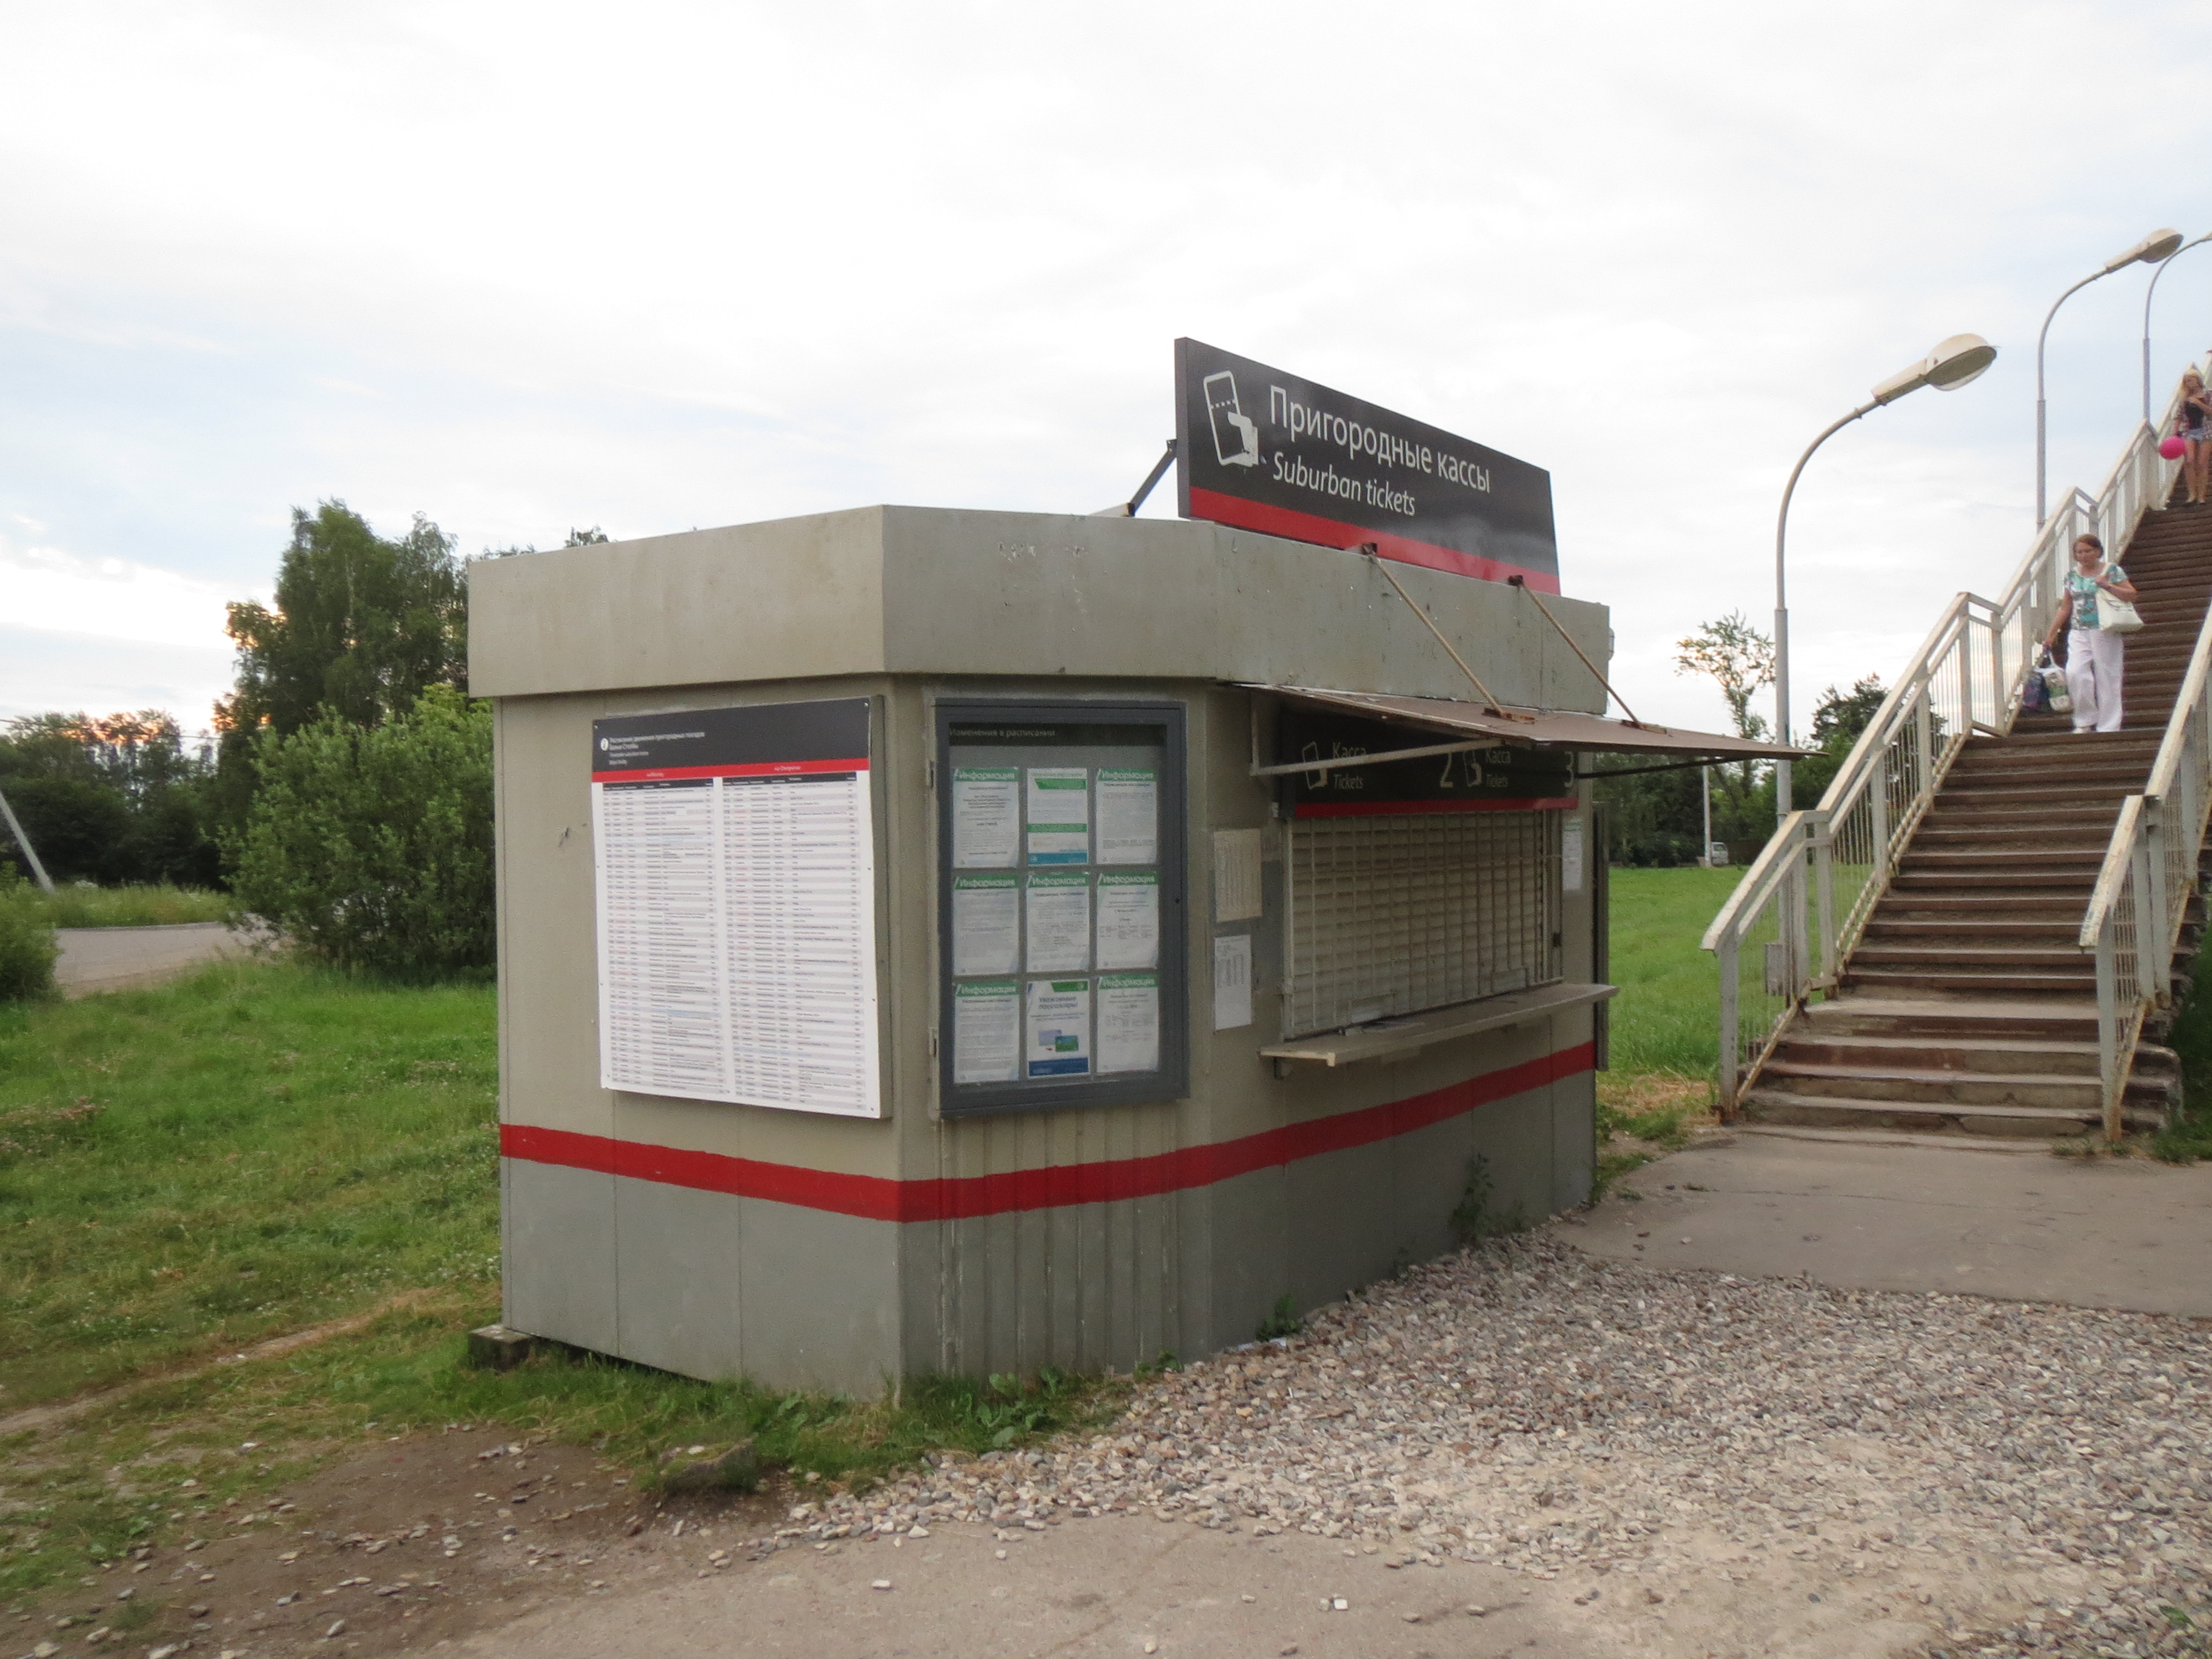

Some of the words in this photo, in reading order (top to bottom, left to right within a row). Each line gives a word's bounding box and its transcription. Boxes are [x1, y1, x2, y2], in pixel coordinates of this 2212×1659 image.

[1270, 384, 1432, 474] Пригородные
[1436, 451, 1491, 494] кассы
[1273, 451, 1361, 502] Suburban
[1366, 478, 1416, 517] tickets
[1485, 748, 1511, 765] Касса
[1564, 751, 1574, 788] 3
[1333, 773, 1364, 790] Tickets
